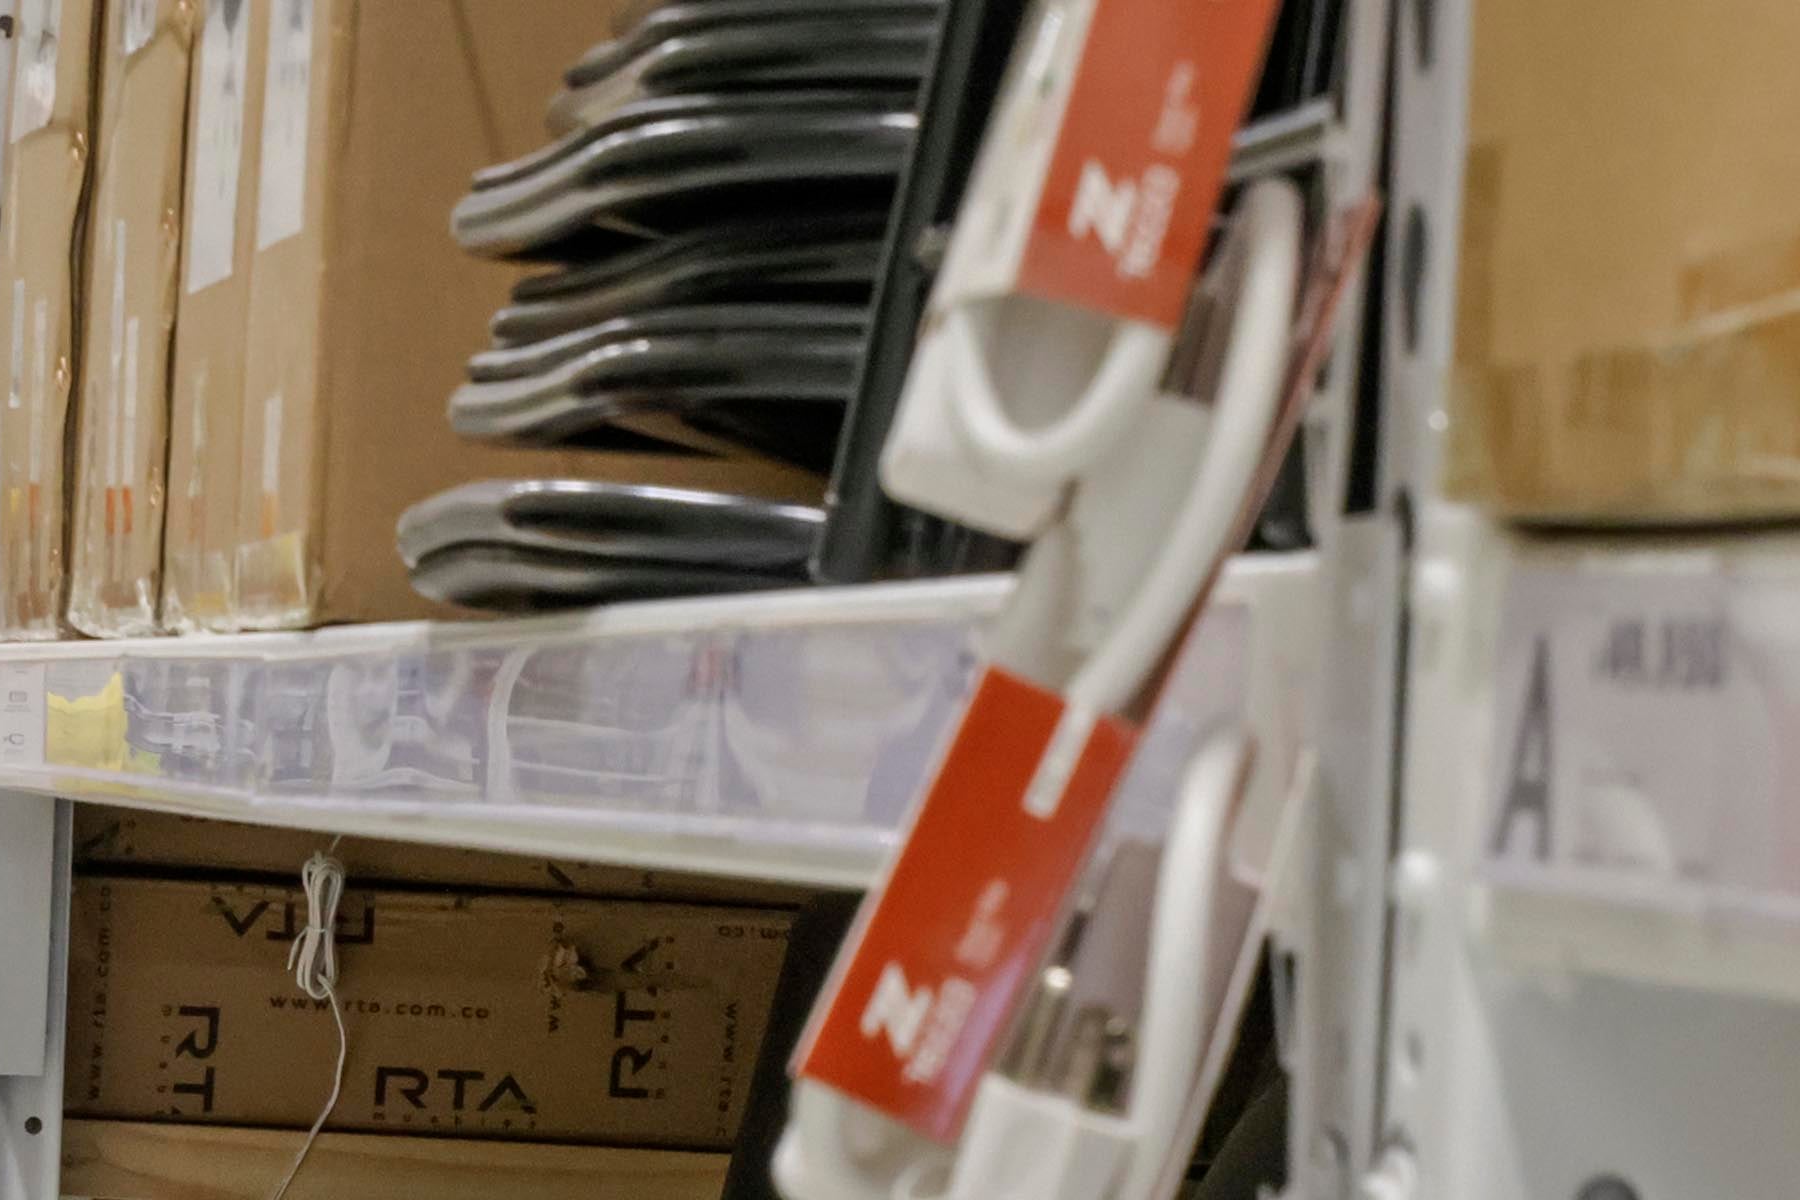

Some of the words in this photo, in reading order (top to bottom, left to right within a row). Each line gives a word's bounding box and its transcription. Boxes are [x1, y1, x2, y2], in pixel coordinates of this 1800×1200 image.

[270, 996, 489, 1020] wwwrta.com.co
[173, 1004, 221, 1115] RT
[374, 1066, 538, 1115] RTA
